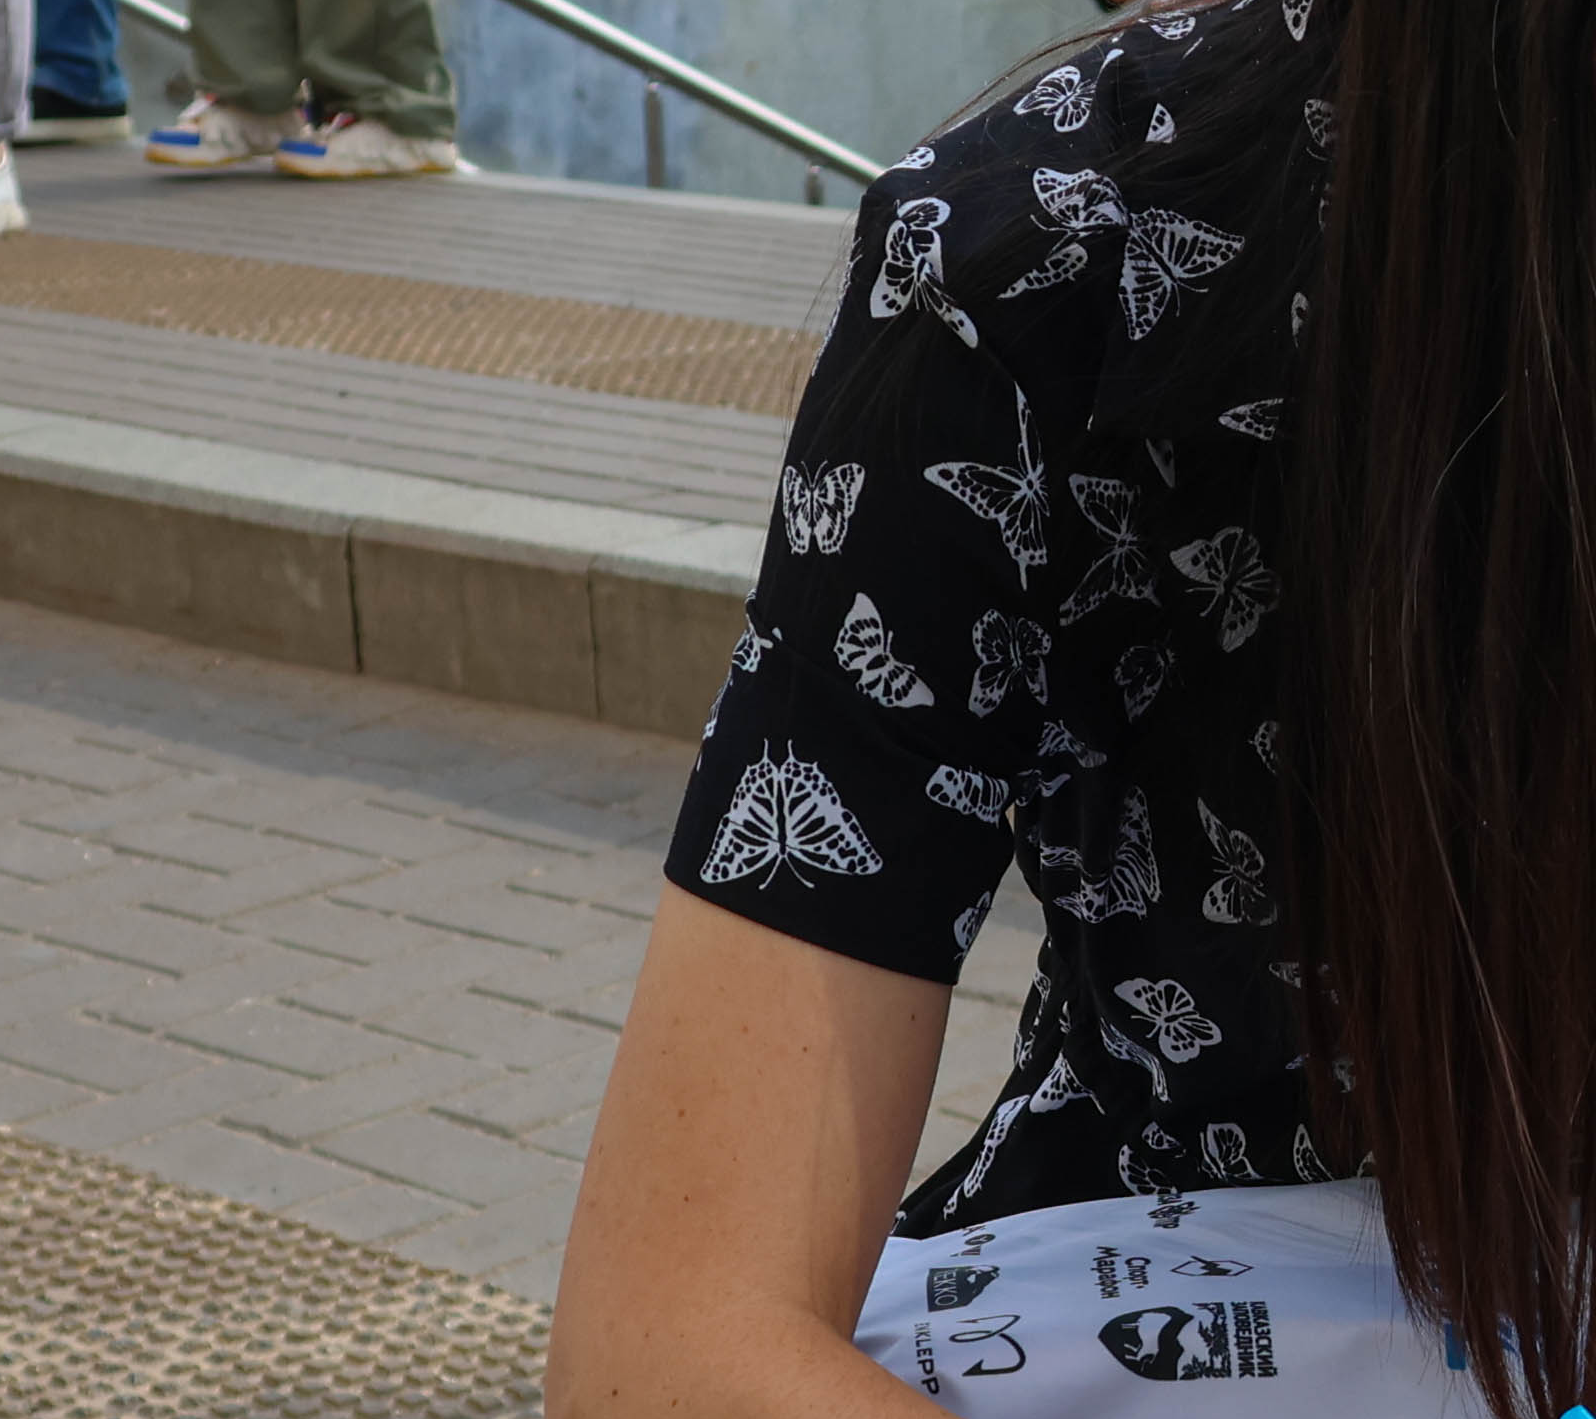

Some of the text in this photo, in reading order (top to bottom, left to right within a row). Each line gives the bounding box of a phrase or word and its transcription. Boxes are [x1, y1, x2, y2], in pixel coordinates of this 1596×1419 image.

[1090, 1246, 1121, 1299] Марафон
[1230, 1301, 1256, 1379] ЗАПОВЕДНИК
[1249, 1301, 1278, 1378] КАВКАЗСКИЙ
